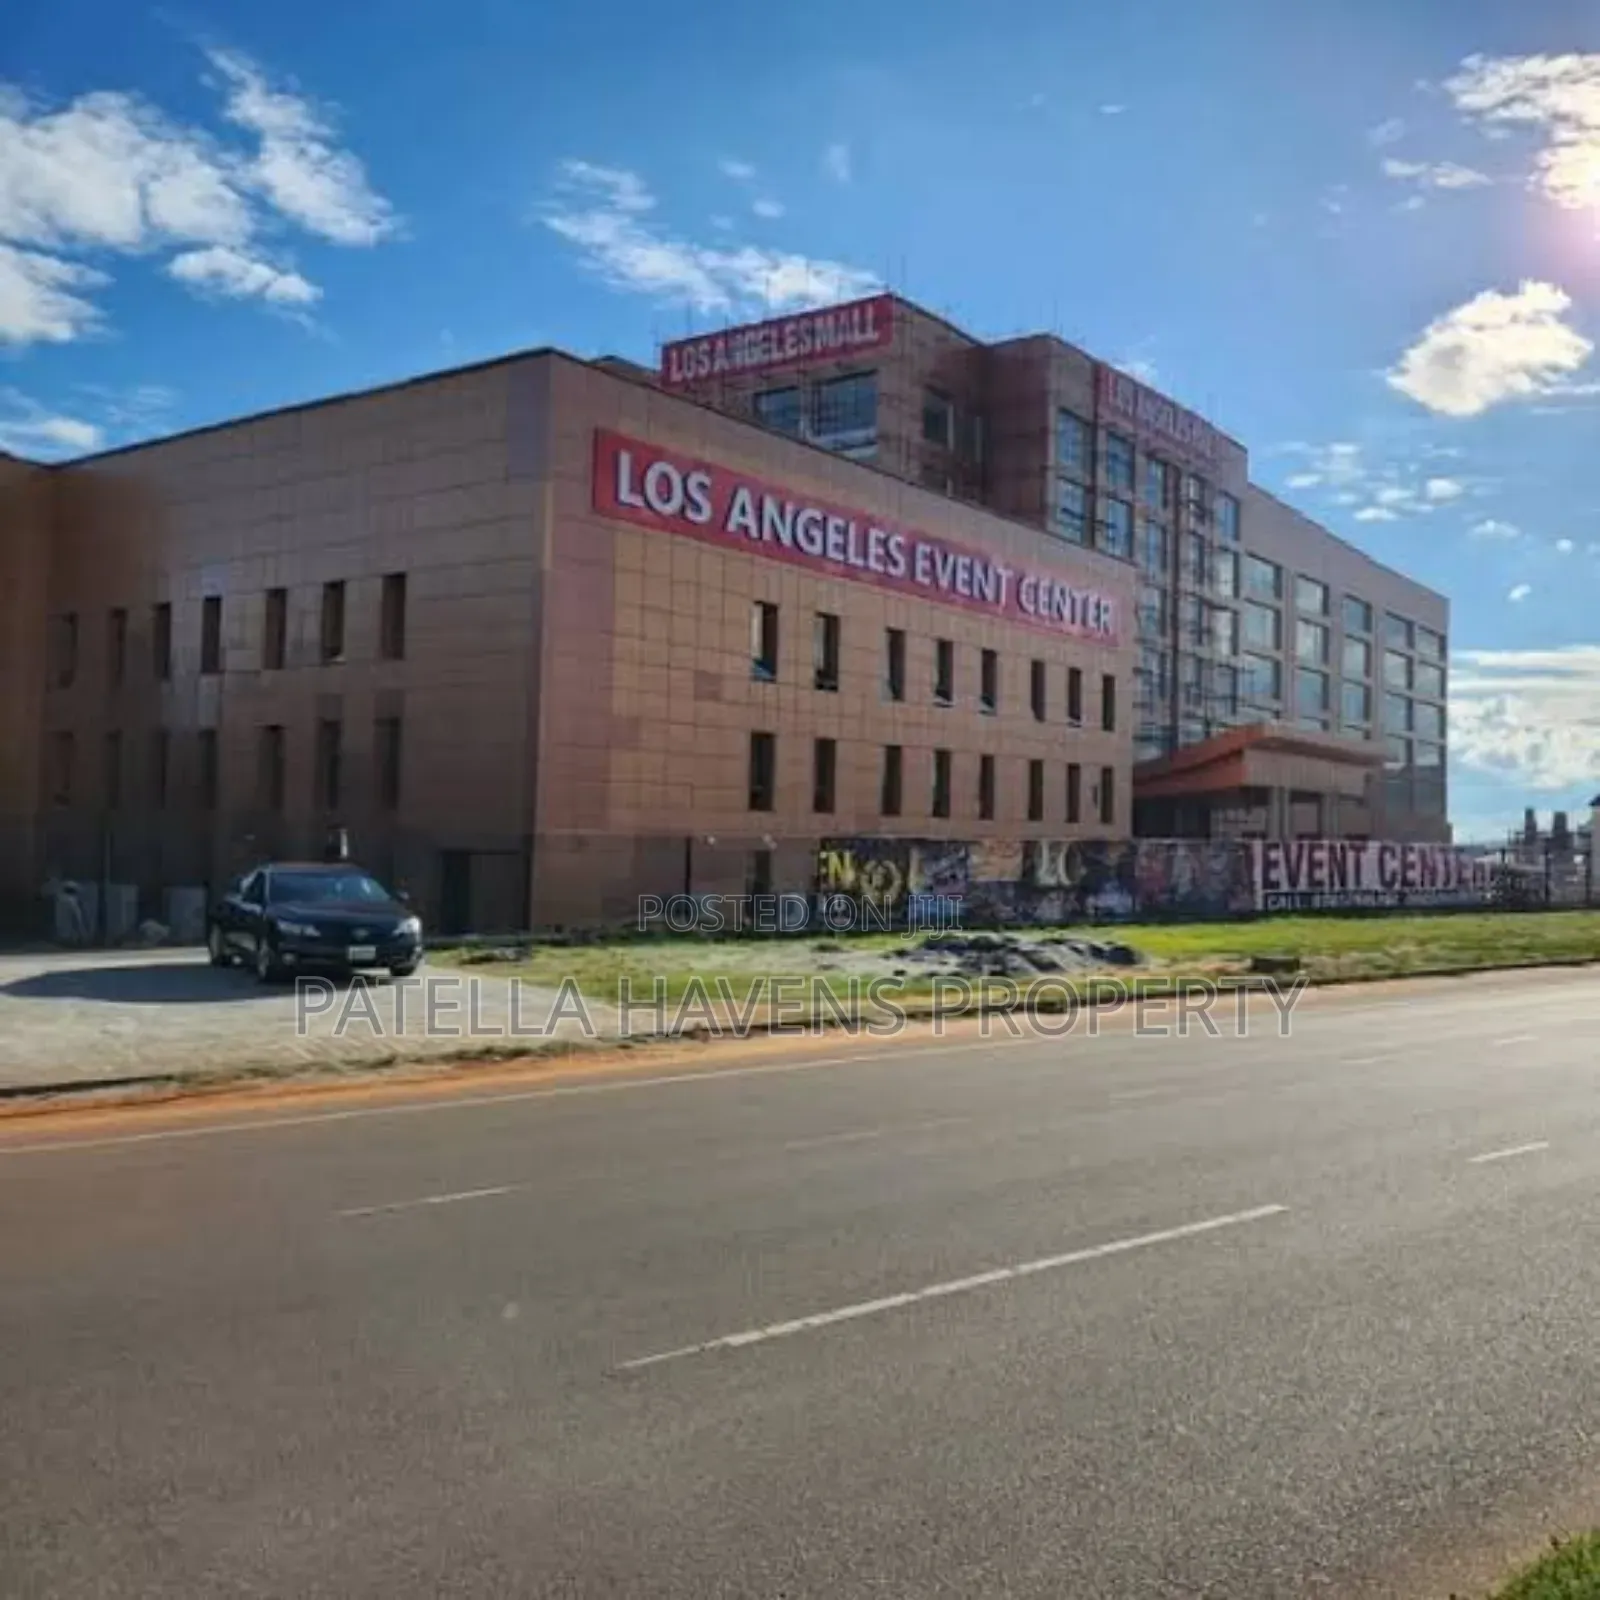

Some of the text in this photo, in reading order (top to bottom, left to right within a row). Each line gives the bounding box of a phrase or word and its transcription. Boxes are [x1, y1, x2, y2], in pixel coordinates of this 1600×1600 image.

[616, 449, 1113, 635] LOS ANGELES EVENT CENTER
[1262, 841, 1367, 890] EVENT
